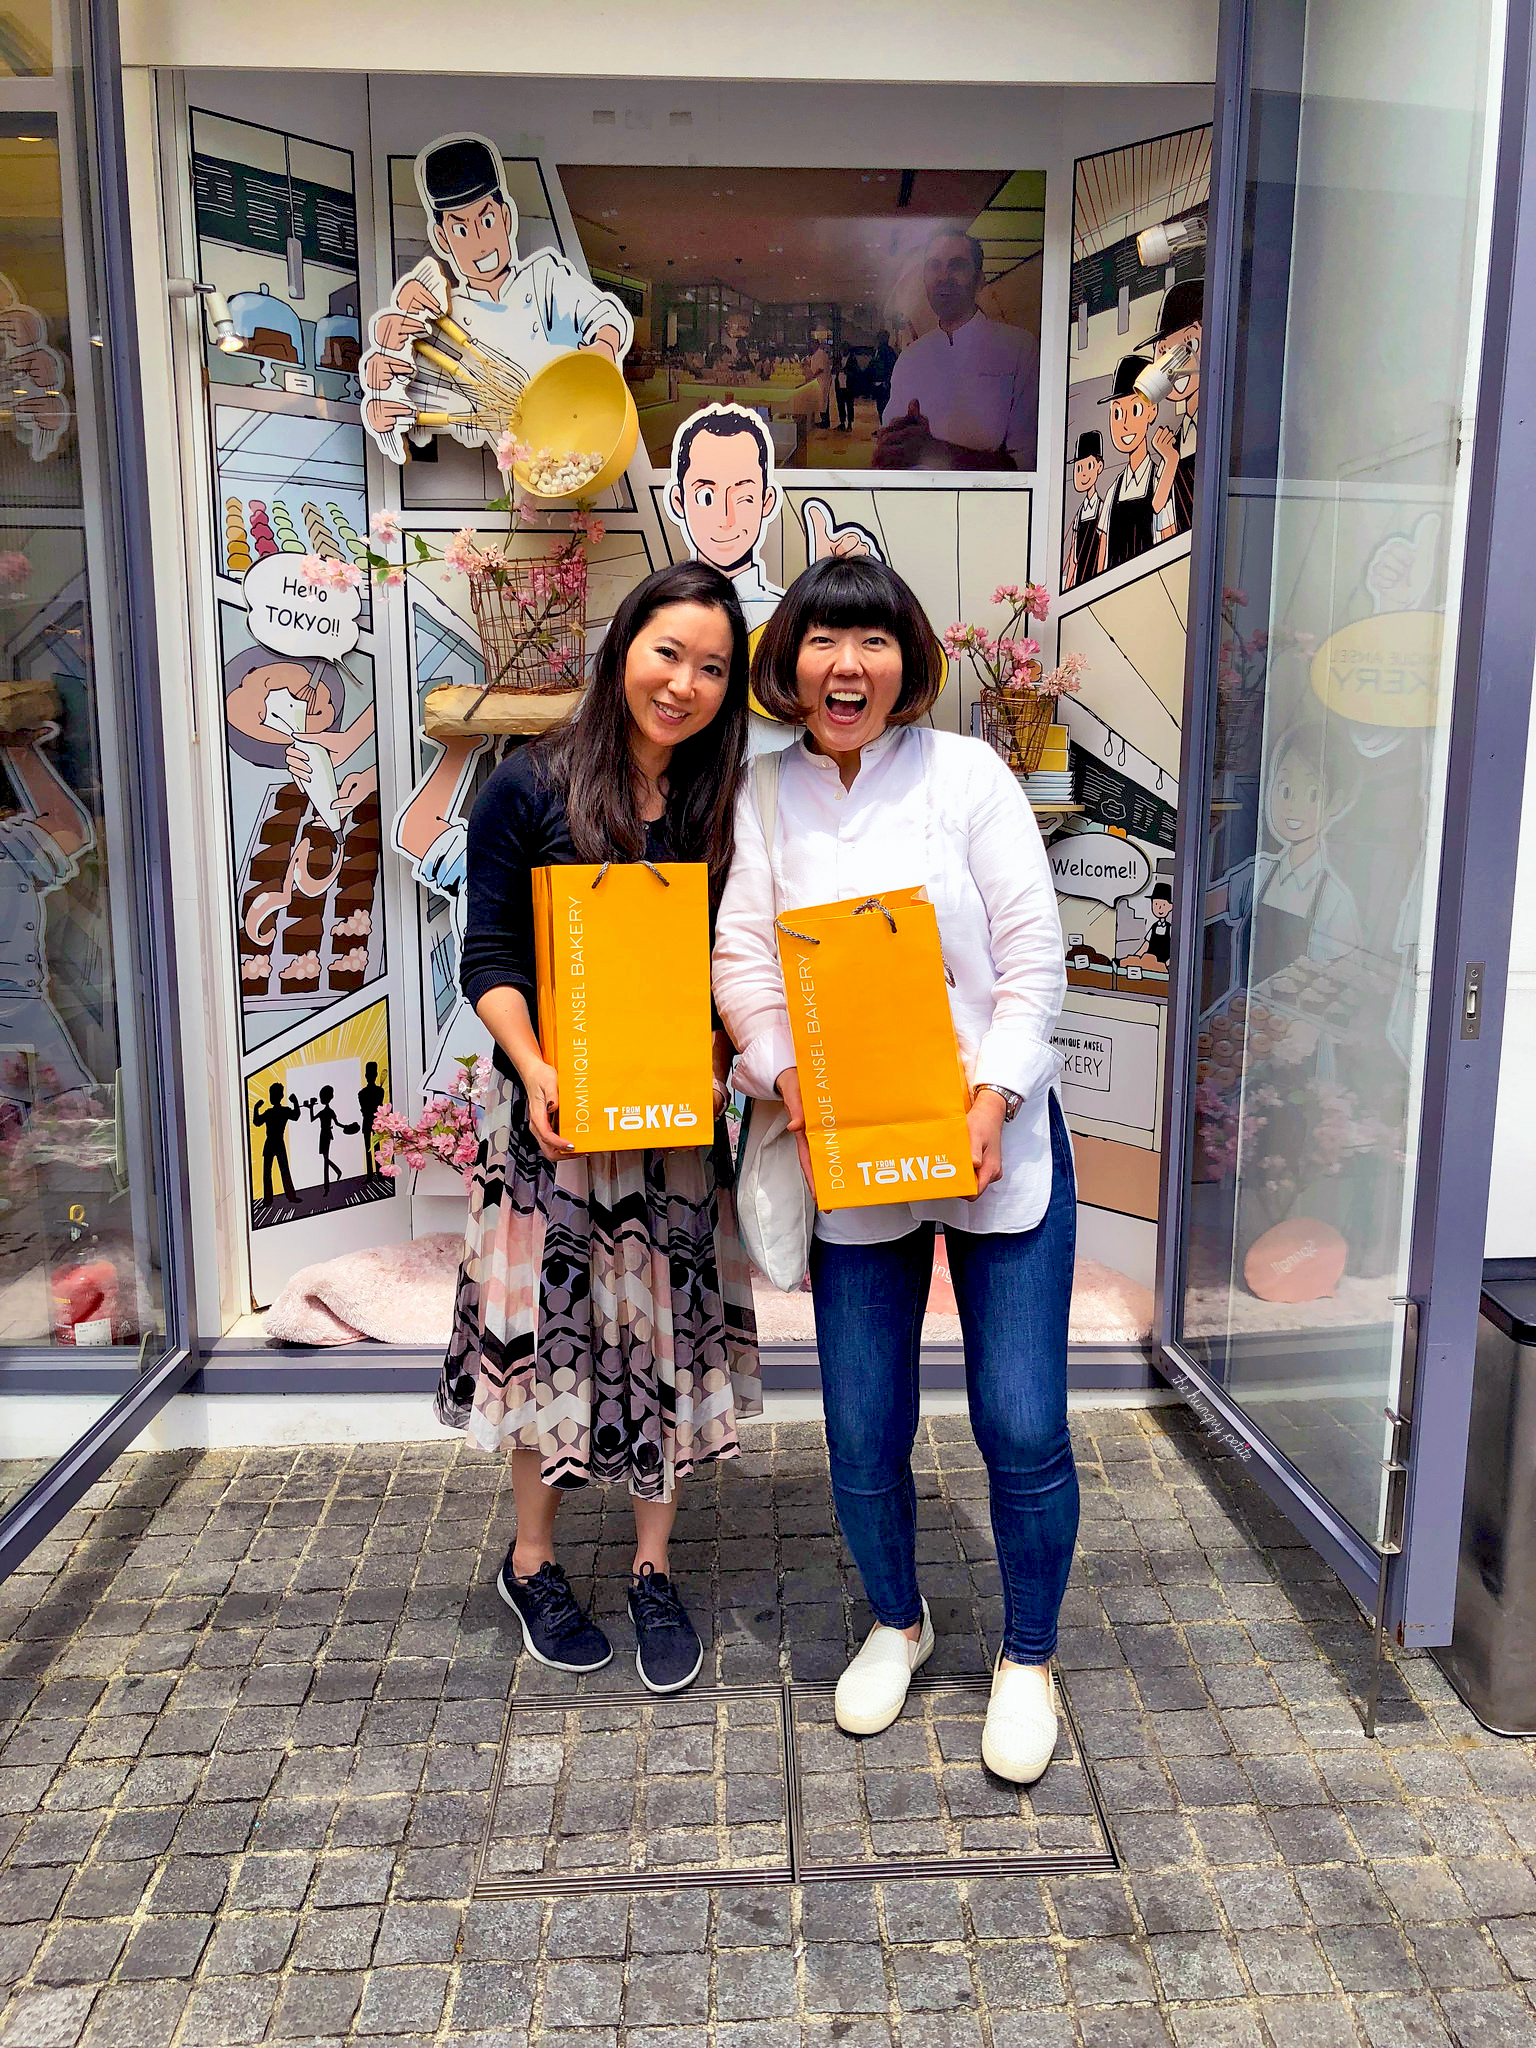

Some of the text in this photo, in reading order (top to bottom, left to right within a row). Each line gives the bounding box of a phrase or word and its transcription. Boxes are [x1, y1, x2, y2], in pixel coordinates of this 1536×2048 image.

[265, 604, 340, 637] TOKYO!!
[1052, 858, 1136, 879] Welcome!!
[568, 896, 589, 1133] DOMINIQUE ANSEL BAKERY
[1083, 1040, 1104, 1052] ANSEL
[796, 953, 845, 1190] DOMINIQUE ANSEL BAKERY
[1063, 1053, 1103, 1077] KERY
[603, 1103, 698, 1131] TOKYO
[621, 1105, 641, 1114] FROM
[857, 1155, 957, 1186] TOKYO
[875, 1159, 896, 1169] FROM
